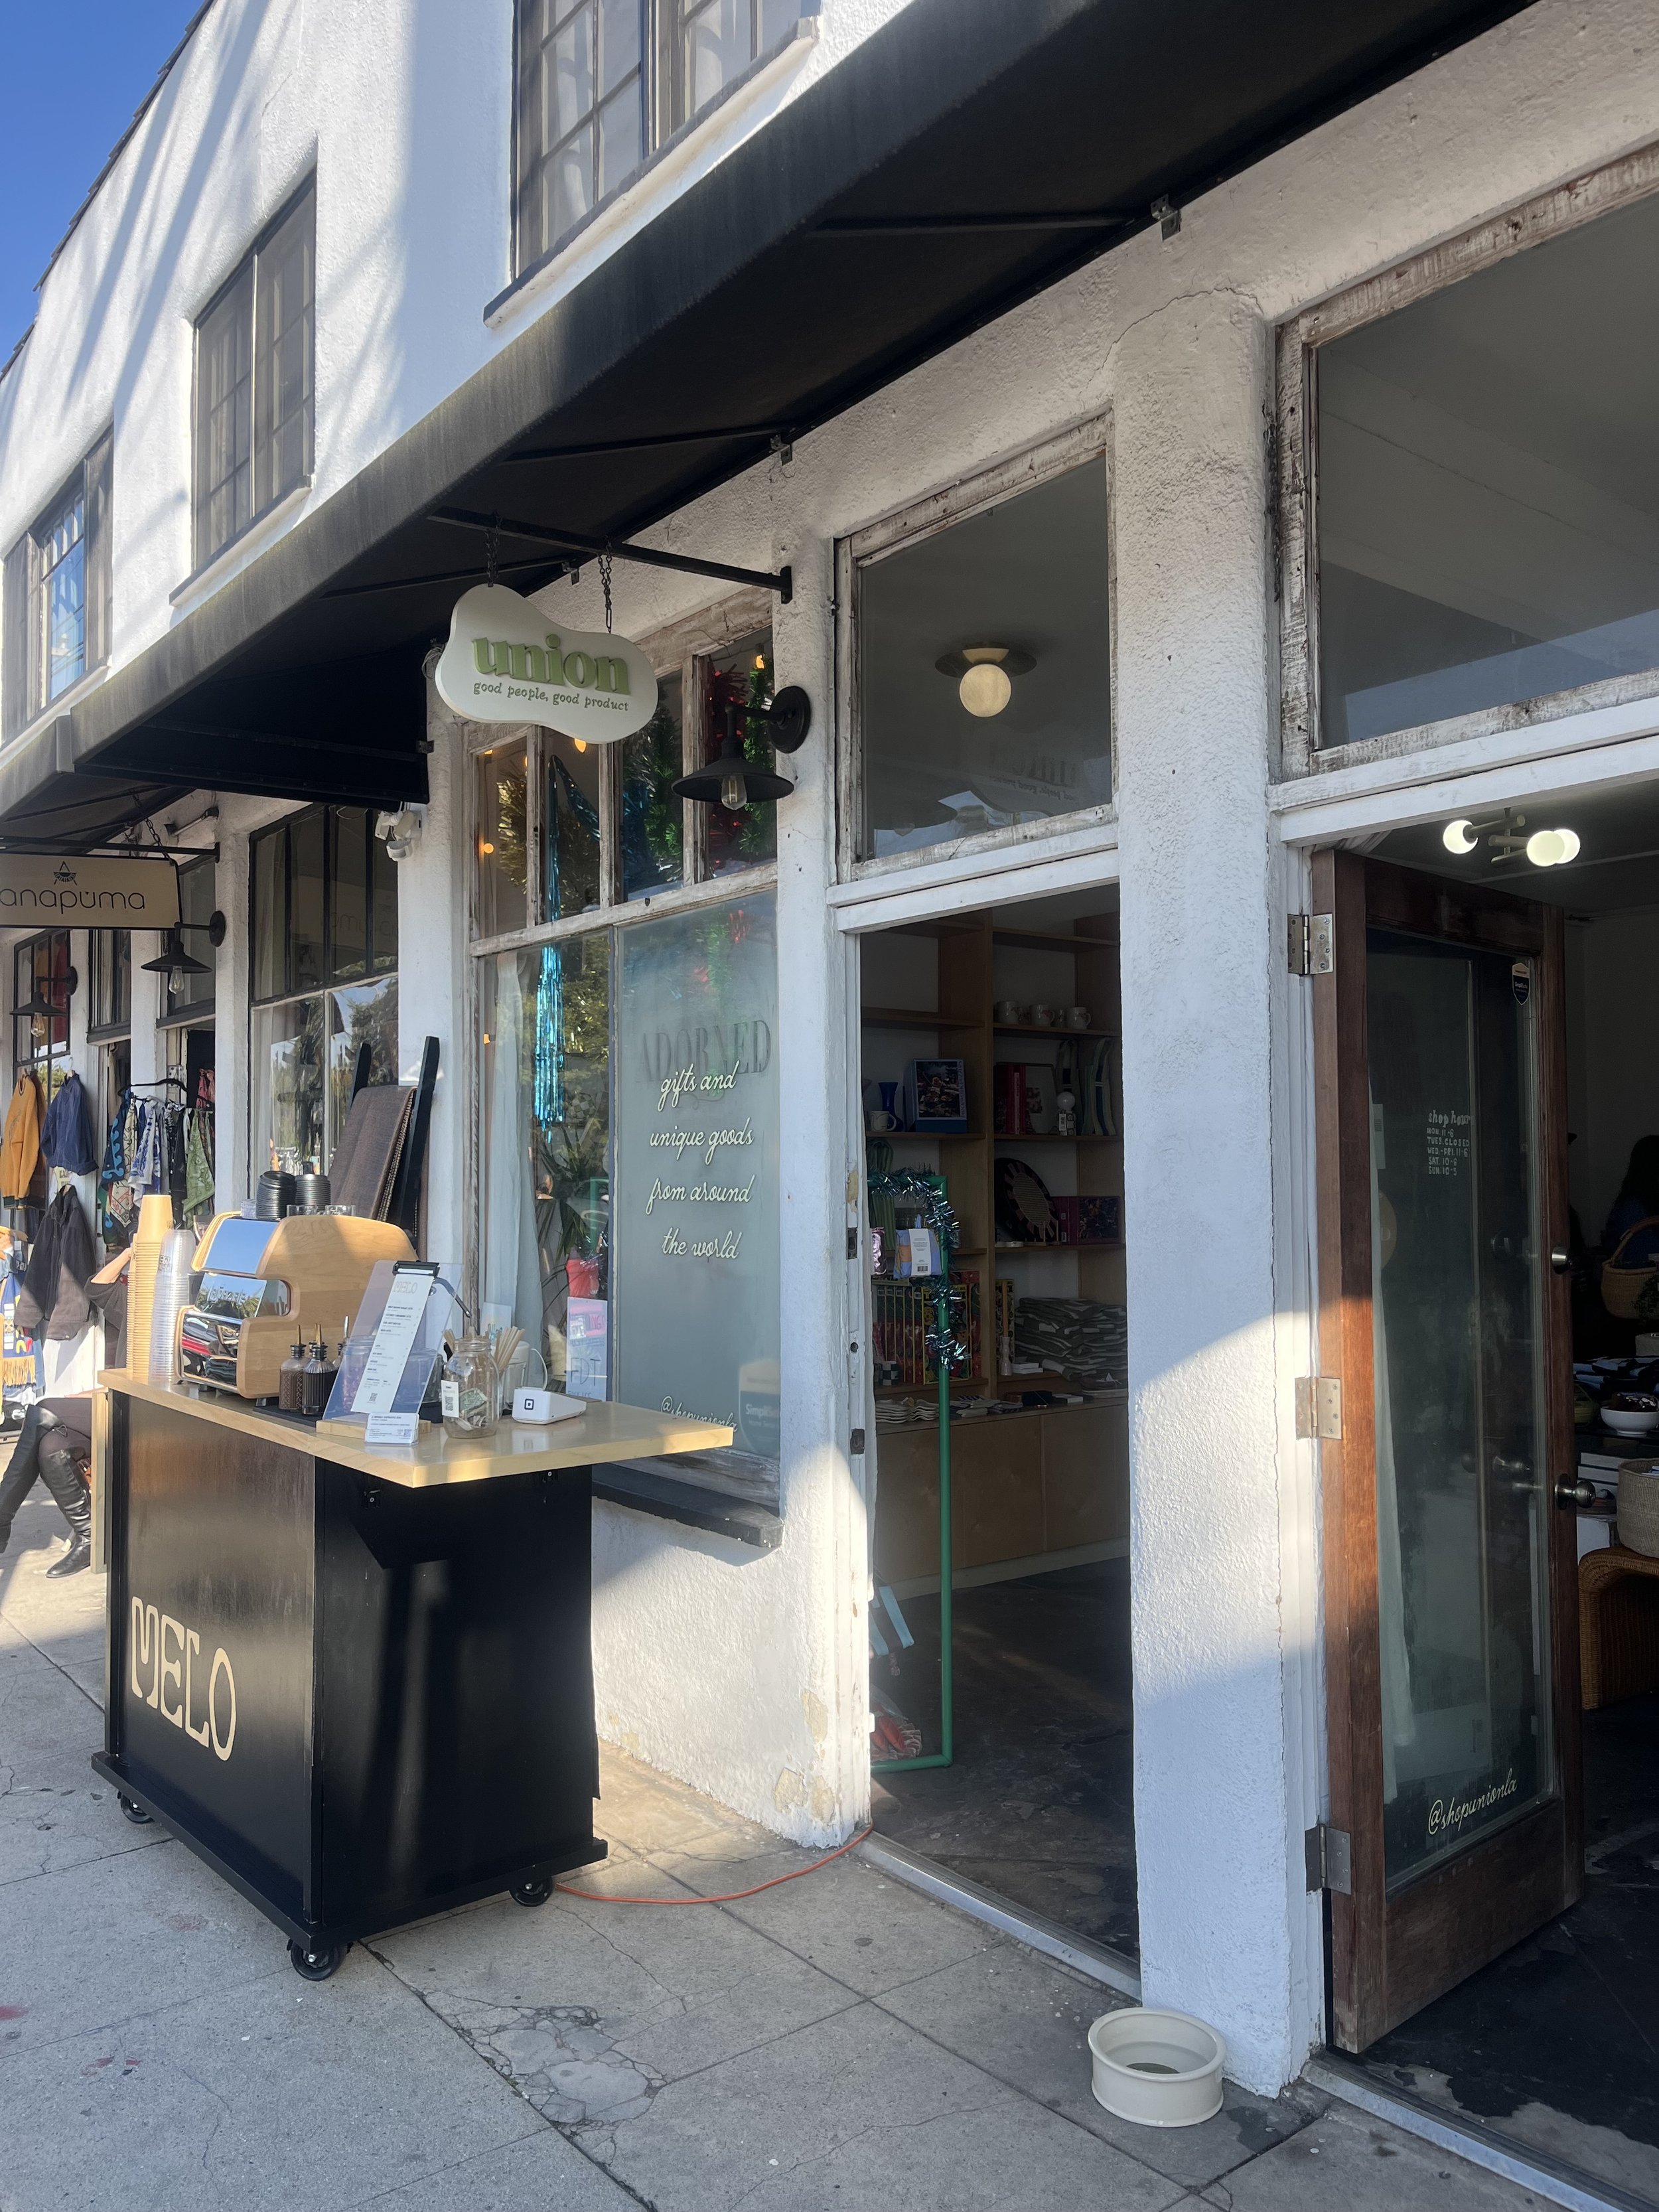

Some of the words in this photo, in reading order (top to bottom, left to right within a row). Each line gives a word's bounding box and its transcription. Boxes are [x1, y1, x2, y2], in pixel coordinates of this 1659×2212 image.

[472, 634, 630, 695] union
[473, 681, 502, 695] good
[508, 686, 548, 701] people,
[553, 693, 579, 705] good
[584, 696, 629, 711] product
[638, 1019, 771, 1083] ADORNED
[658, 1064, 697, 1112] gifts
[700, 1060, 739, 1090] and
[650, 1126, 705, 1160] unique
[708, 1118, 754, 1165] goods
[1428, 1110, 1449, 1128] shop
[1445, 1138, 1470, 1147] CLOSED
[646, 1178, 687, 1215] from
[690, 1174, 755, 1203] around
[662, 1227, 687, 1255] the
[691, 1230, 742, 1259] world
[132, 1596, 236, 1761] MELO
[1428, 1767, 1518, 1835] @shopunionla
